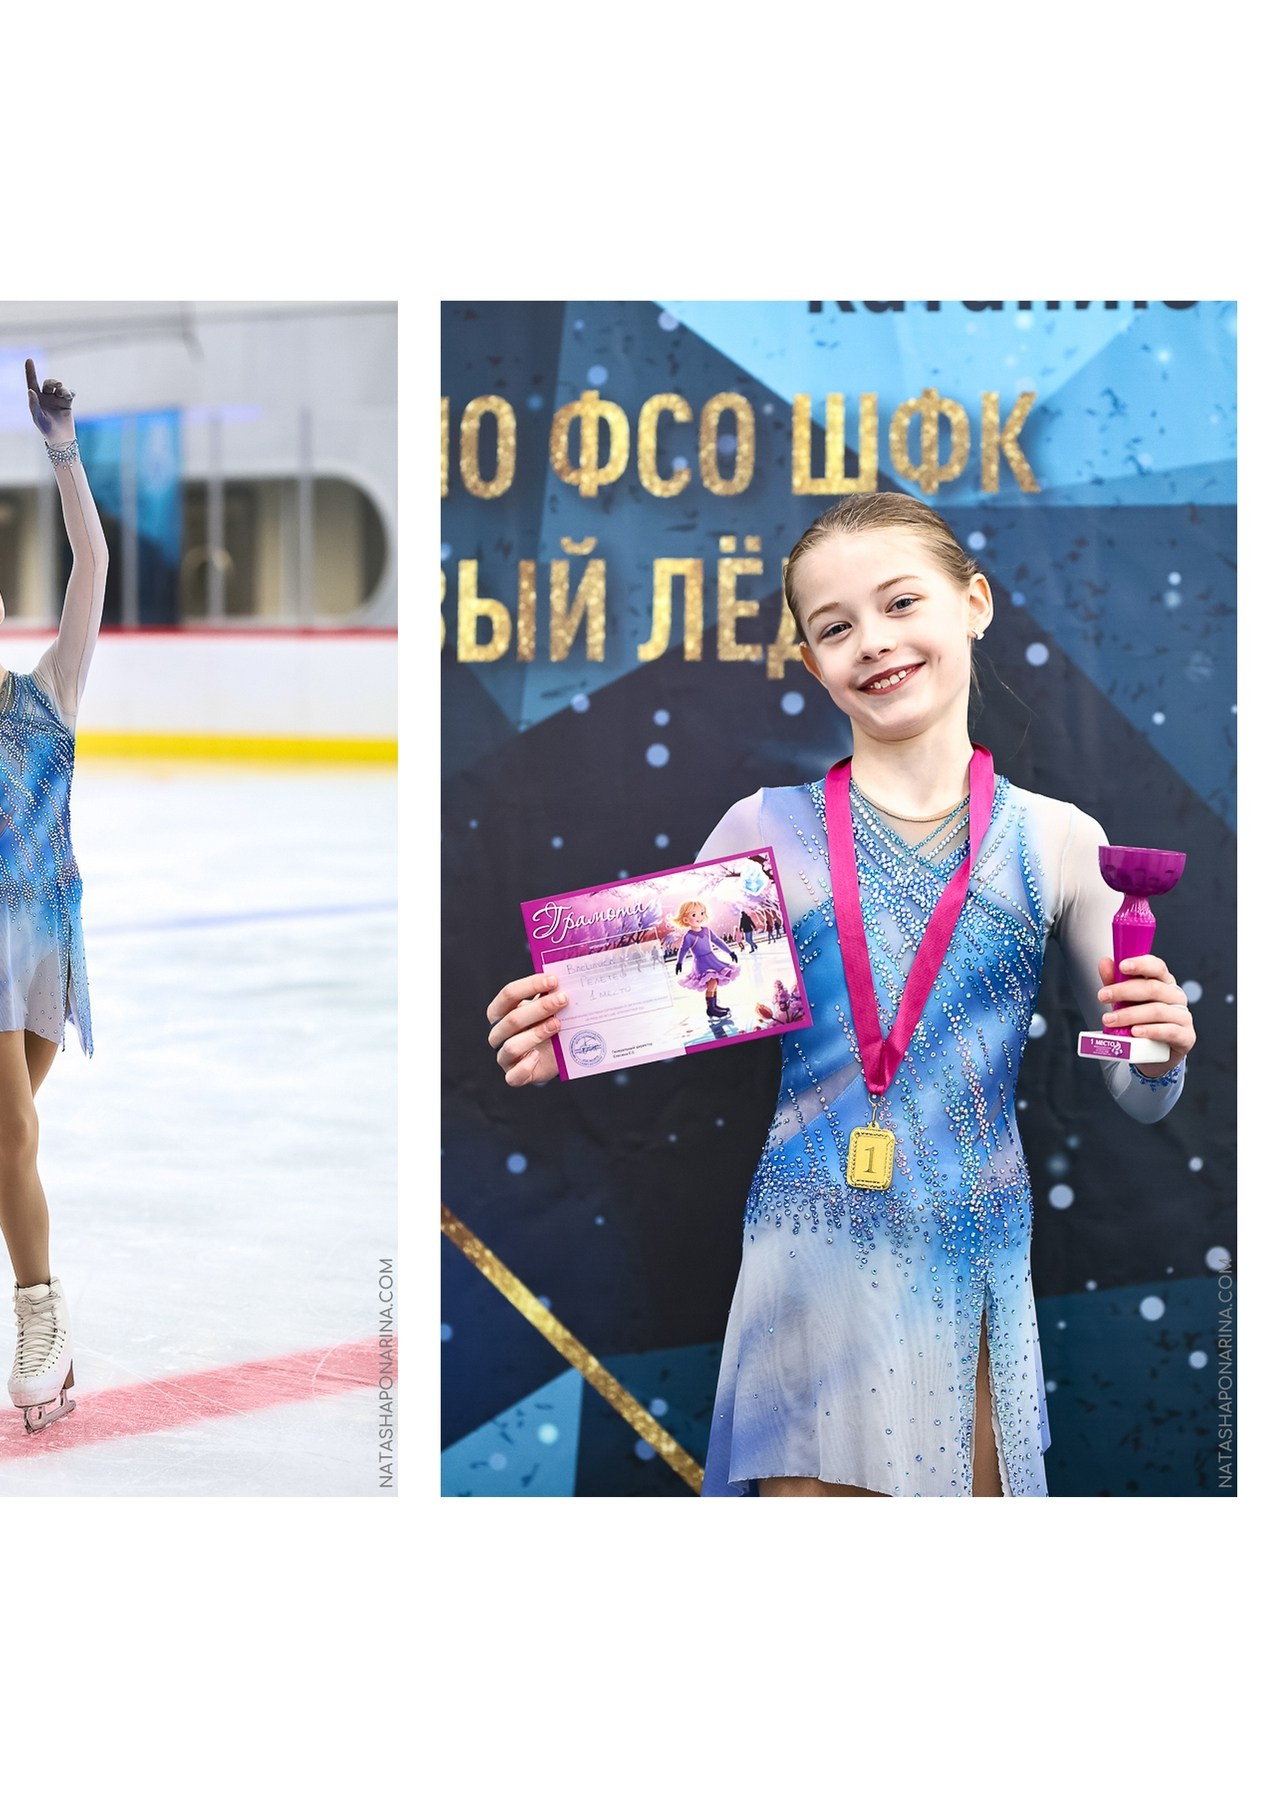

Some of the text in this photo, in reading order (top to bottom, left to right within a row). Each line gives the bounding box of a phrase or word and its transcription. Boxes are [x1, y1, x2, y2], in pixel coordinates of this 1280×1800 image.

[441, 388, 1041, 498] О ФСО ШФК
[441, 536, 607, 663] ЫЙ
[532, 901, 650, 944] Грамота
[863, 1146, 877, 1174] 1
